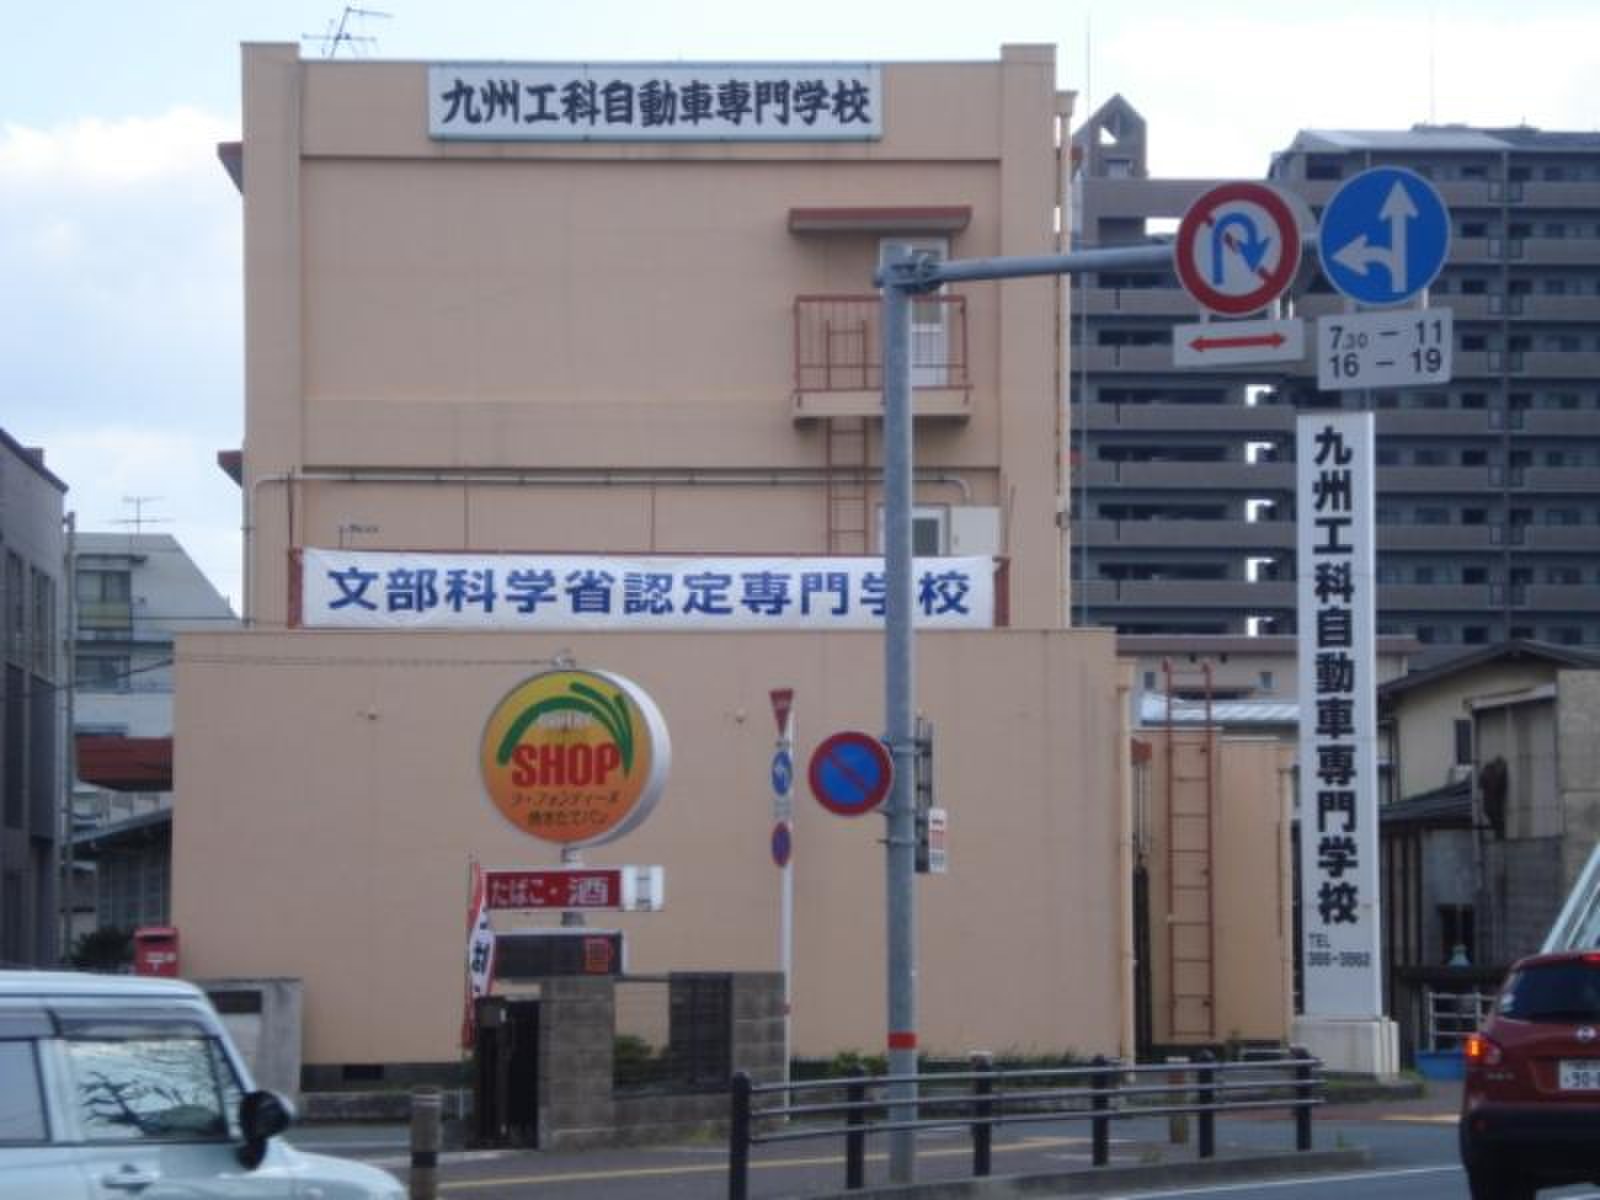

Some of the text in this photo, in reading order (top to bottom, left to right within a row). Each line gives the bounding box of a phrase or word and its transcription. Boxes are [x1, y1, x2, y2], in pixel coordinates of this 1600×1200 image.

[442, 79, 872, 127] 九州工科自動車専門学校
[1414, 319, 1442, 345] 11
[1329, 351, 1360, 379] 16
[1410, 346, 1443, 374] 19
[1312, 425, 1359, 925] 九州工科自動車専門学校
[511, 741, 621, 788] SHOP
